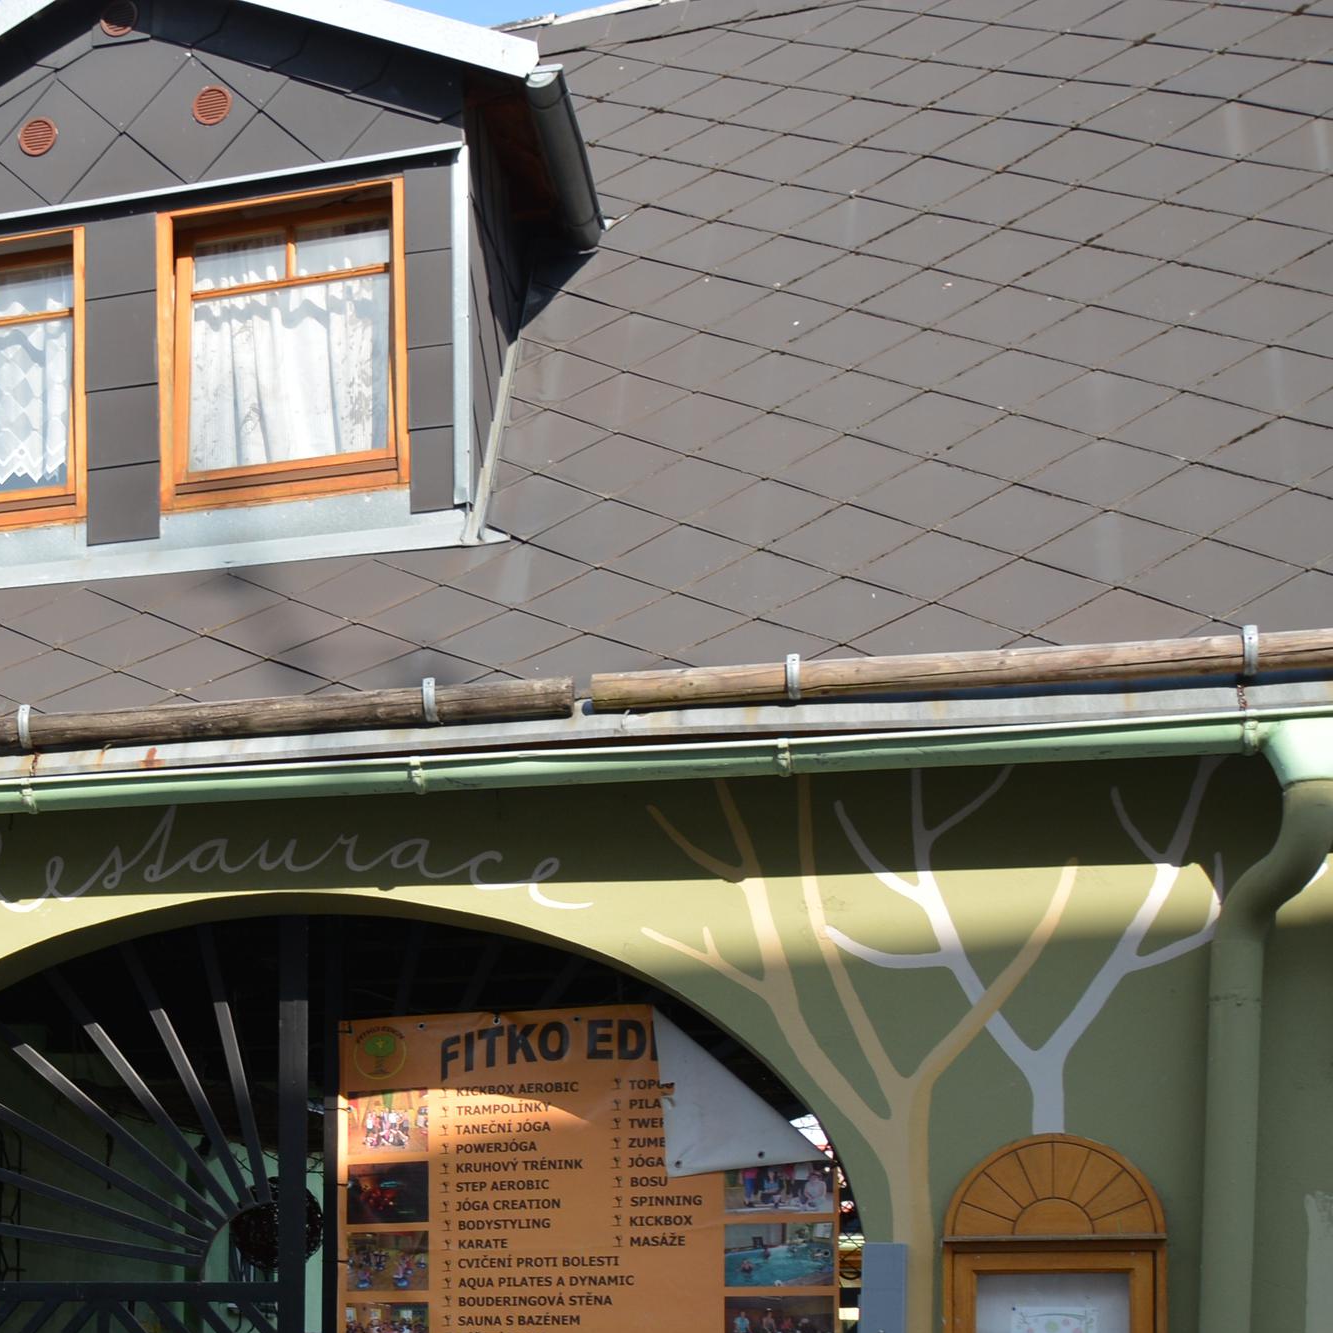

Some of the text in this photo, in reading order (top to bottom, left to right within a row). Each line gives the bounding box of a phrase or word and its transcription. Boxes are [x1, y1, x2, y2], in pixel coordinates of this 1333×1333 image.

[440, 1022, 569, 1083] FITKO
[456, 1081, 579, 1097] KICKBOX AEROBIC
[456, 1100, 552, 1116] TRAMPOLÍNKY
[455, 1121, 551, 1135] TANEČNÍ JÓGA
[456, 1139, 537, 1154] POWERJÓGA
[456, 1155, 584, 1173] KRUHOVÝ TRÉNINK
[627, 1154, 665, 1168] JÓGA
[456, 1179, 550, 1192] STEP AEROBIC
[630, 1176, 668, 1187] BOSU
[456, 1196, 561, 1212] JÓGA CREATION
[630, 1194, 703, 1207] SPINNING
[457, 1218, 551, 1231] BODYSTYLING
[629, 1215, 693, 1227] KICKBOX
[457, 1238, 508, 1250] KARATE
[629, 1232, 685, 1247] MASÁŽE
[458, 1256, 620, 1270] CVIČENÍ PROTI BOLESTI
[458, 1275, 635, 1289] AQUA PILATES A DYNAMIC
[458, 1292, 613, 1307] BOUDERINGOVÁ STĚNA
[458, 1312, 581, 1326] SAUNA S BAZÉNEM
